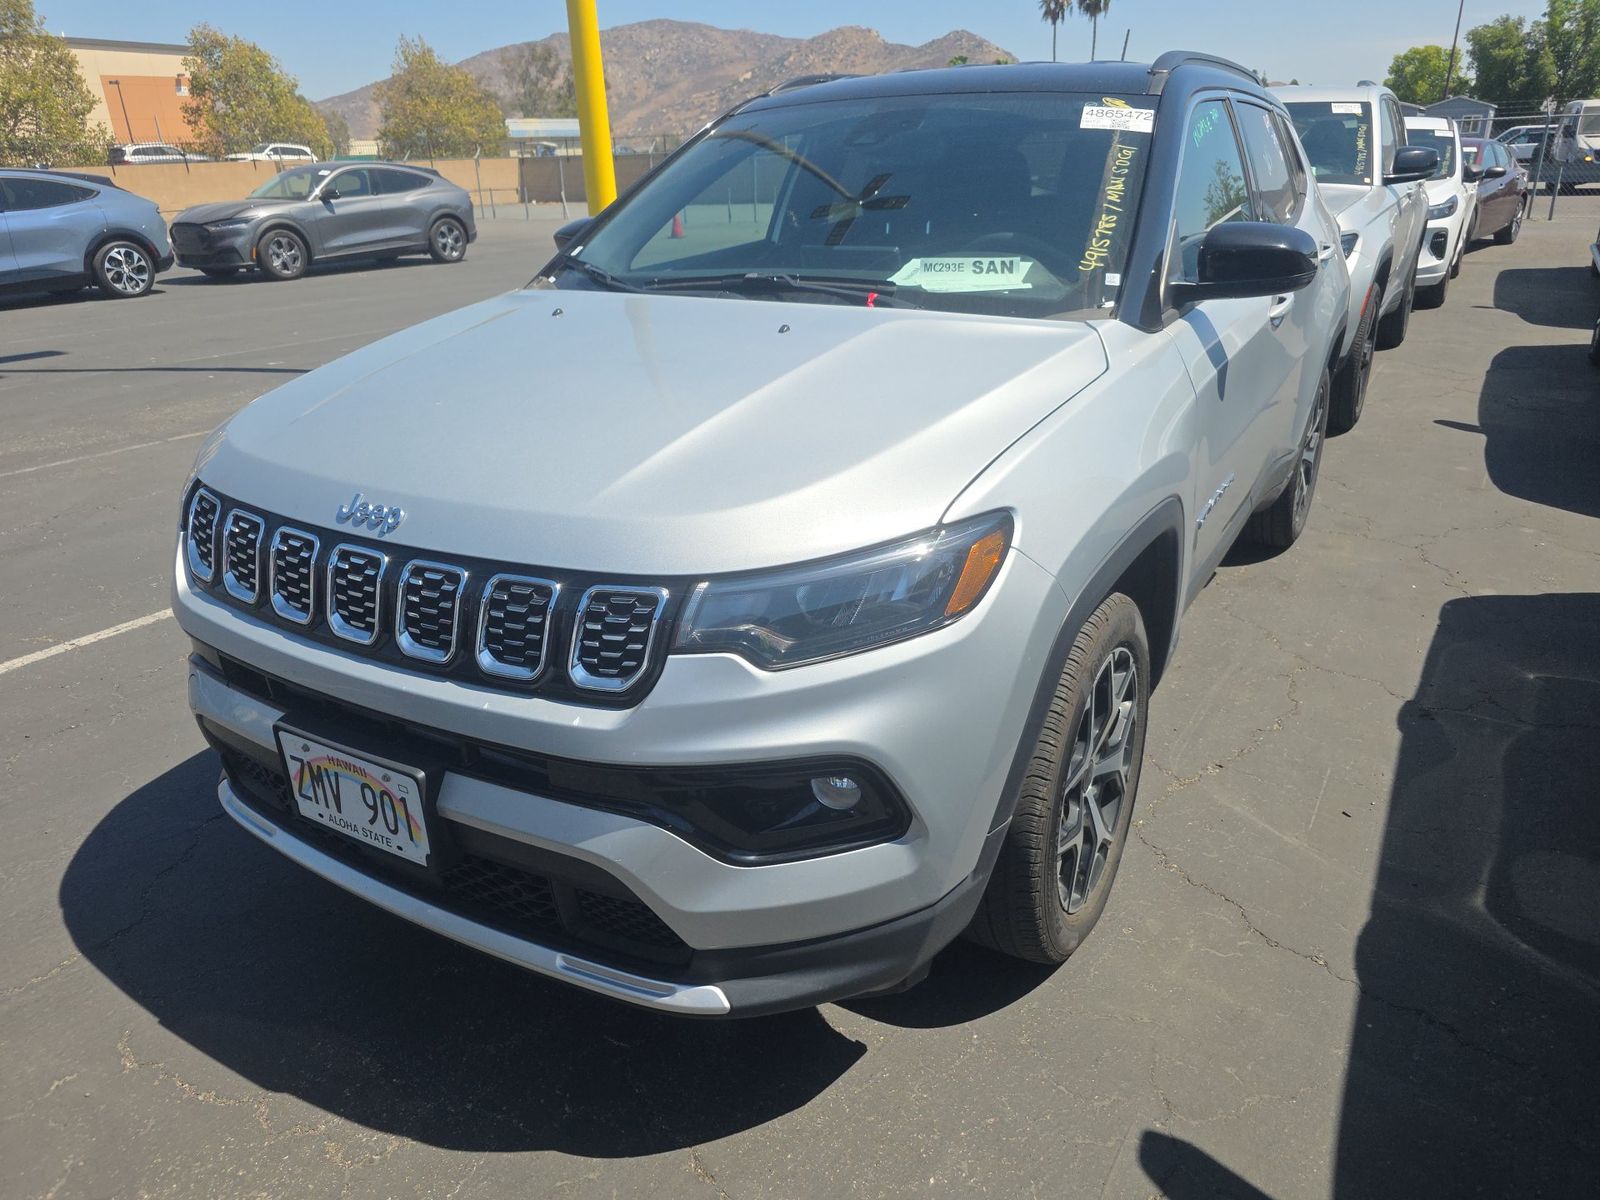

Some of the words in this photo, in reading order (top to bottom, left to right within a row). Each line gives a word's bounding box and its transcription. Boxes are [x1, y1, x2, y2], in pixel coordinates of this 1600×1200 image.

[1086, 109, 1153, 120] 4865472
[923, 262, 965, 273] MC293E
[972, 260, 1014, 274] SAN
[336, 493, 406, 538] Jeep
[326, 754, 369, 778] HAWAII
[289, 754, 342, 814] ZMV
[360, 782, 414, 842] 901
[328, 813, 360, 834] ALOHA
[361, 826, 393, 848] STATE
